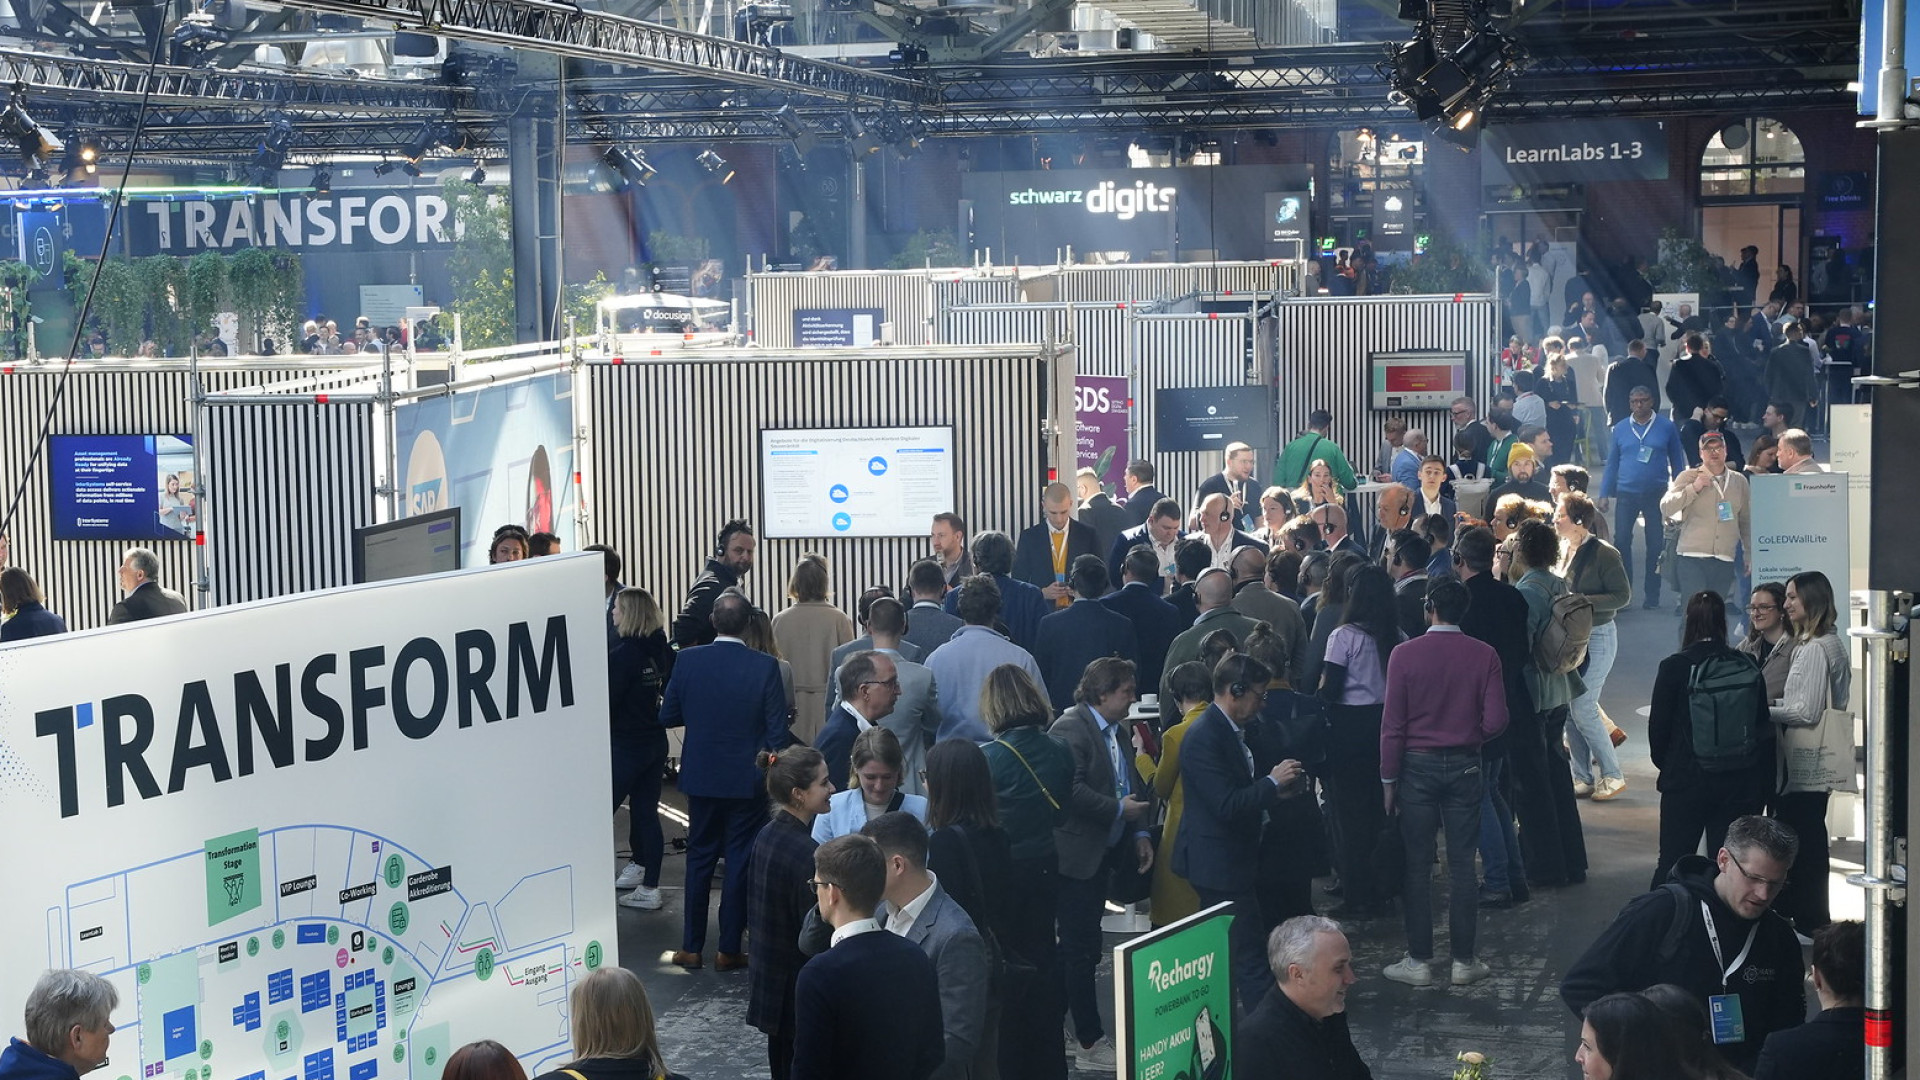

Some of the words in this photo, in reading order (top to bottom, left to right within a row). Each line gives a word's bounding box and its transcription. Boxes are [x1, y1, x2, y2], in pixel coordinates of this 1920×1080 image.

[1506, 142, 1605, 164] LearnLabs
[1610, 141, 1643, 160] 1-3
[1009, 188, 1083, 205] schwarz
[1086, 180, 1176, 220] digits
[652, 310, 692, 322] docusign
[1075, 386, 1110, 413] SDS
[1075, 424, 1100, 433] oftware
[1076, 450, 1098, 459] ervices
[413, 490, 435, 515] SAP
[1758, 534, 1827, 545] CoLEDWallLite
[35, 614, 575, 819] TRANSFORM
[208, 841, 257, 860] Transformation
[223, 859, 242, 869] Stage
[281, 884, 292, 893] VIP
[293, 878, 316, 891] Lounge
[409, 872, 439, 886] Garderobe
[340, 884, 376, 901] Co-Working
[409, 882, 451, 898] Akkreditierung
[524, 964, 546, 976] Eingang
[1148, 952, 1214, 993] Rechargy
[395, 981, 414, 992] Lounge
[524, 974, 548, 986] Ausgang
[1155, 995, 1192, 1017] POWERBANK
[1200, 985, 1209, 997] GO
[1140, 1037, 1168, 1062] HANDY
[1169, 1027, 1191, 1048] AKKU
[1140, 1061, 1165, 1080] LEER?
